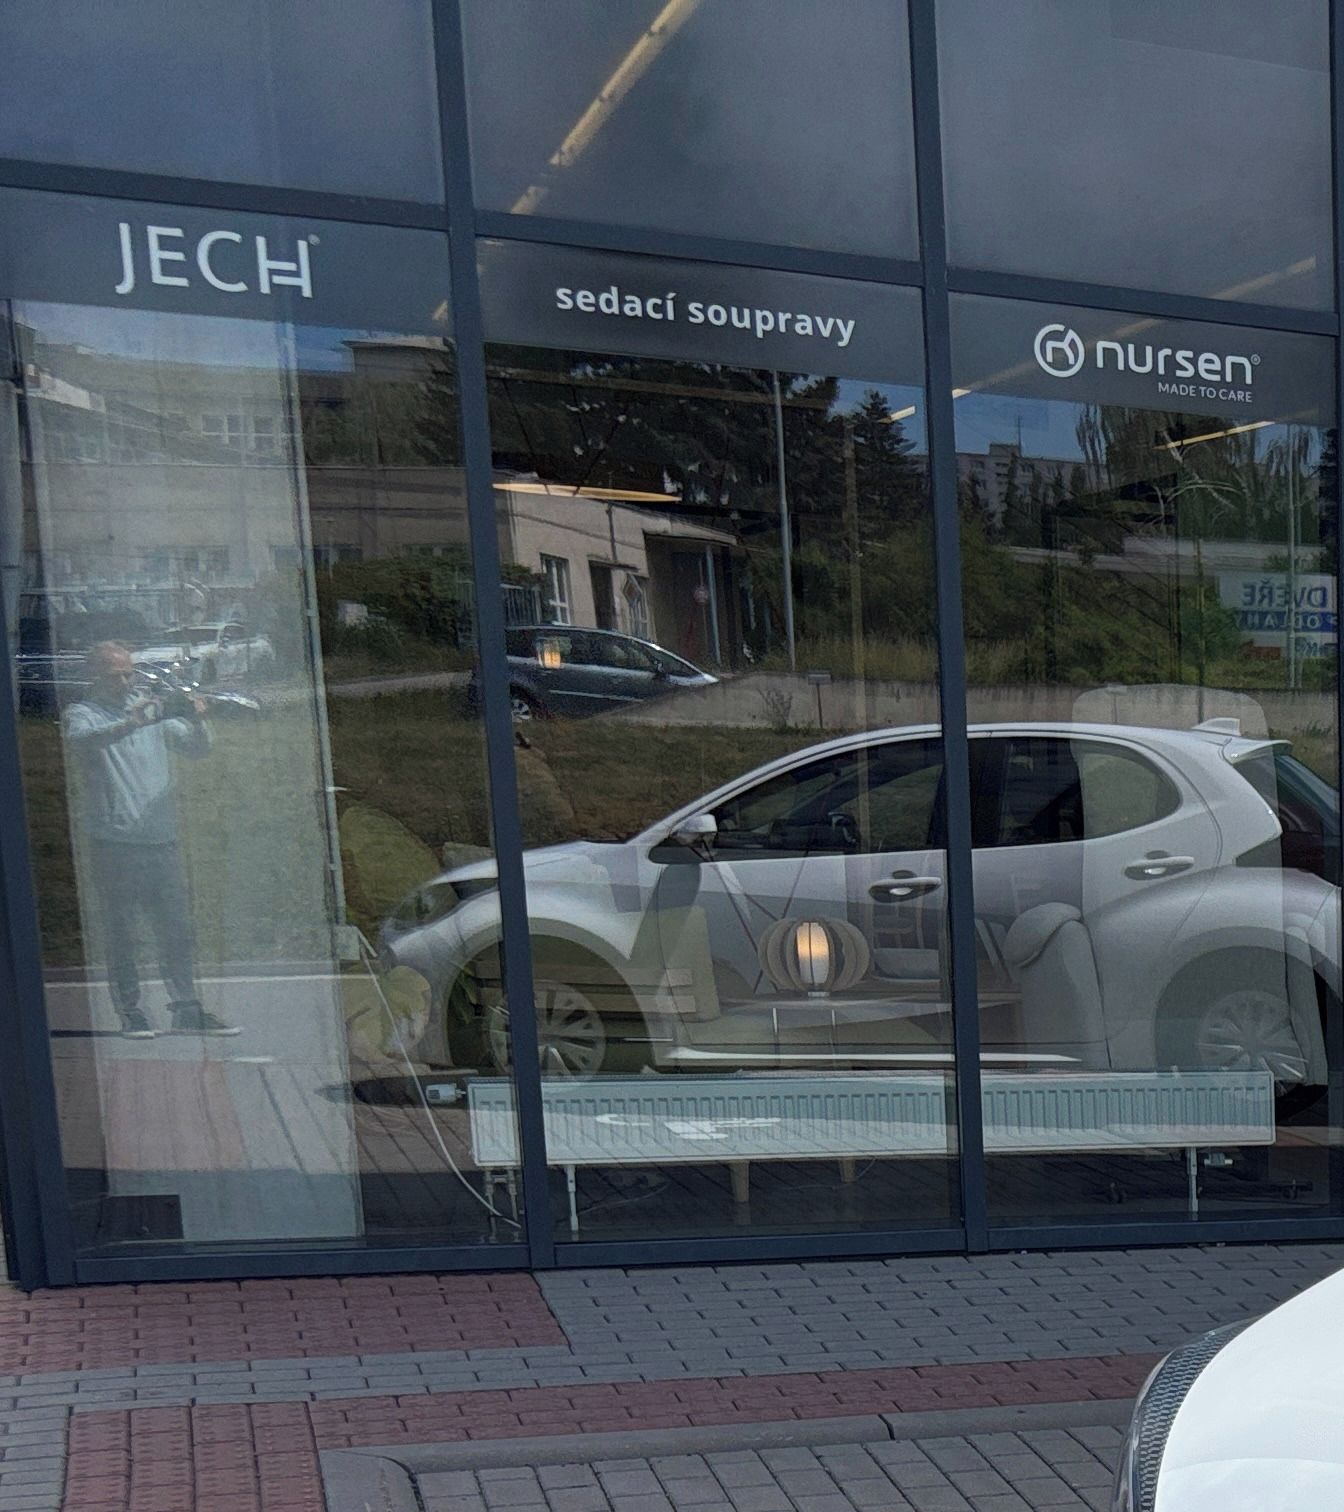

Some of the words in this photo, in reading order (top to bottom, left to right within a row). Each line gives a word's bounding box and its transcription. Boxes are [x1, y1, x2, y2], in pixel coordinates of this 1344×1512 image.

[114, 222, 313, 298] JECH
[555, 285, 677, 321] sedací
[687, 300, 856, 347] soupravy
[1157, 382, 1197, 397] MADE
[1199, 386, 1217, 398] TO
[1218, 388, 1253, 402] CARE
